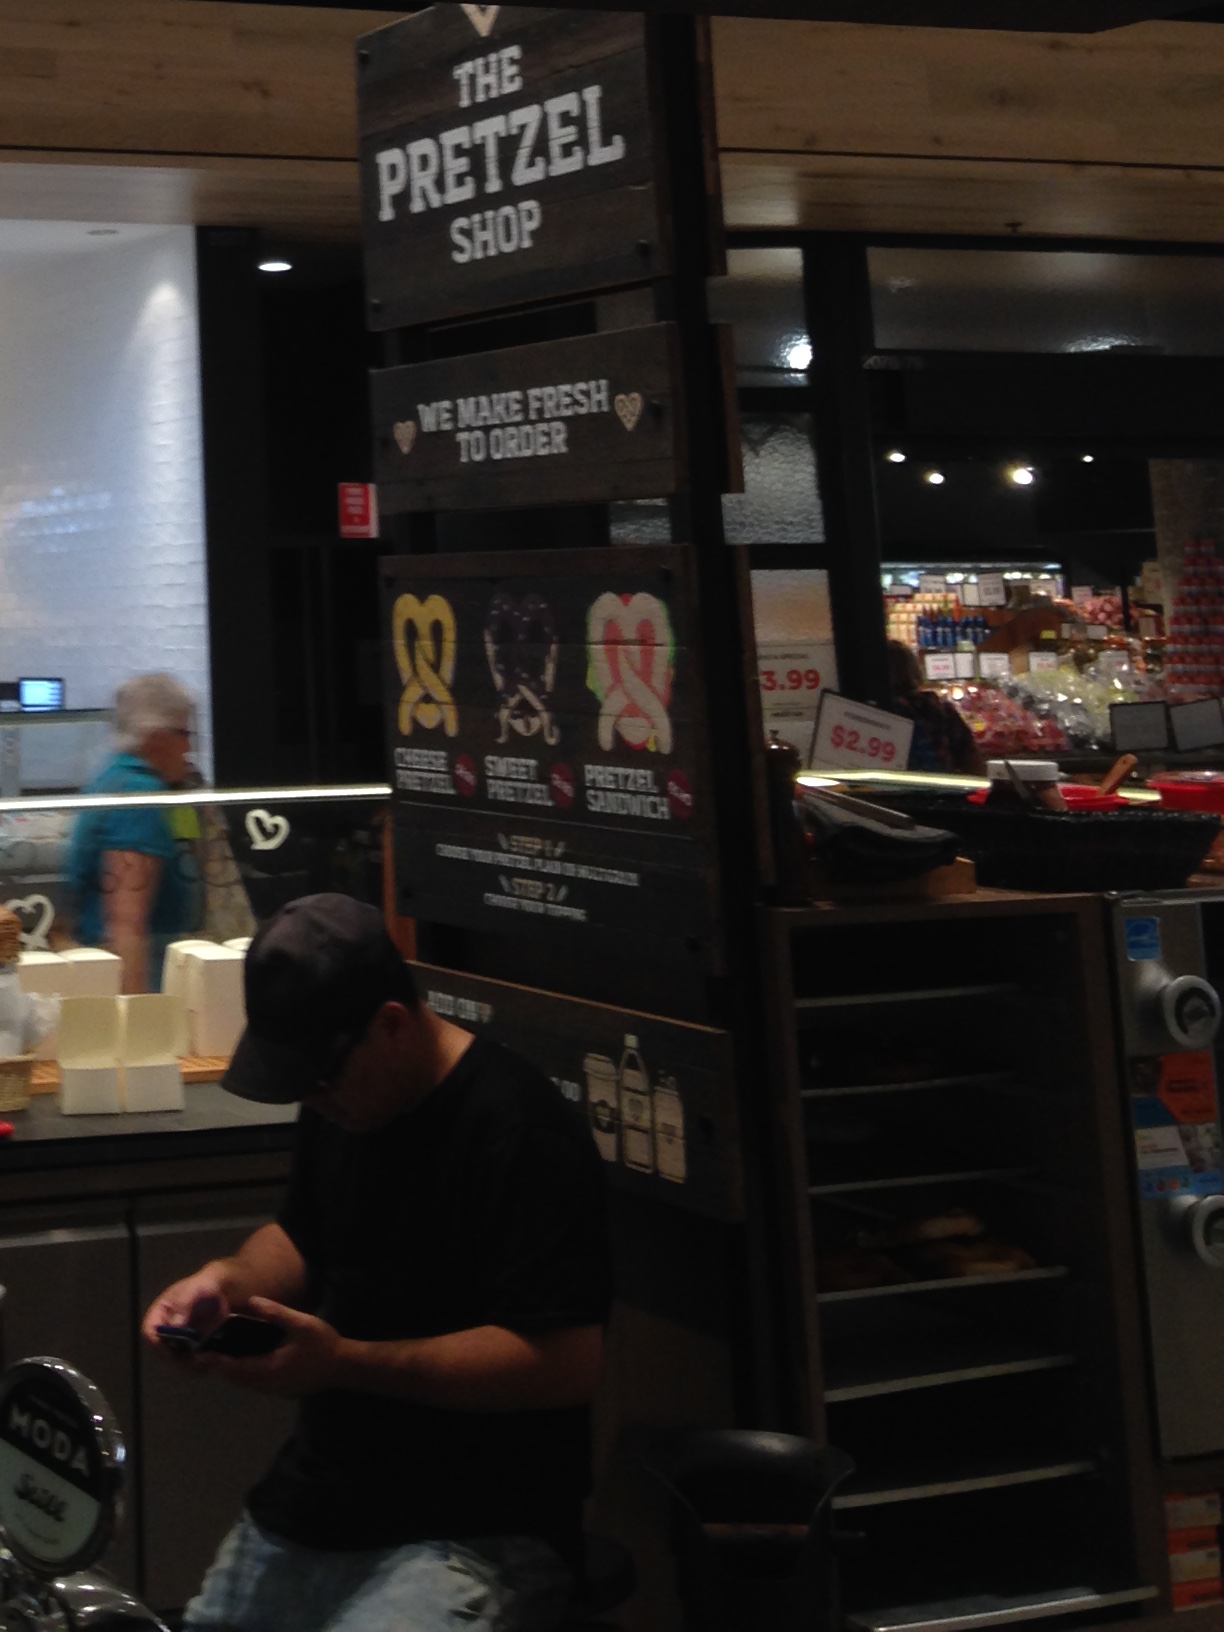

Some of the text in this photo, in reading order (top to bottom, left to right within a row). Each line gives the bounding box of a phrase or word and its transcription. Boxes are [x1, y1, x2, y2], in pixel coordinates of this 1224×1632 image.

[452, 45, 524, 108] THE
[376, 84, 626, 222] PRETZEL
[449, 199, 543, 264] SHOP
[417, 379, 611, 432] WE MAKE FRESH
[456, 421, 569, 463] TO ORDER
[759, 669, 821, 692] 3.99
[831, 724, 896, 763] $2.99
[396, 769, 457, 795] PRETZEL
[484, 755, 539, 782] SWEET
[584, 764, 660, 794] PRETZEL
[486, 779, 556, 807] PRETZEL
[585, 789, 672, 821] SANDWICH
[7, 1402, 92, 1479] MODA
